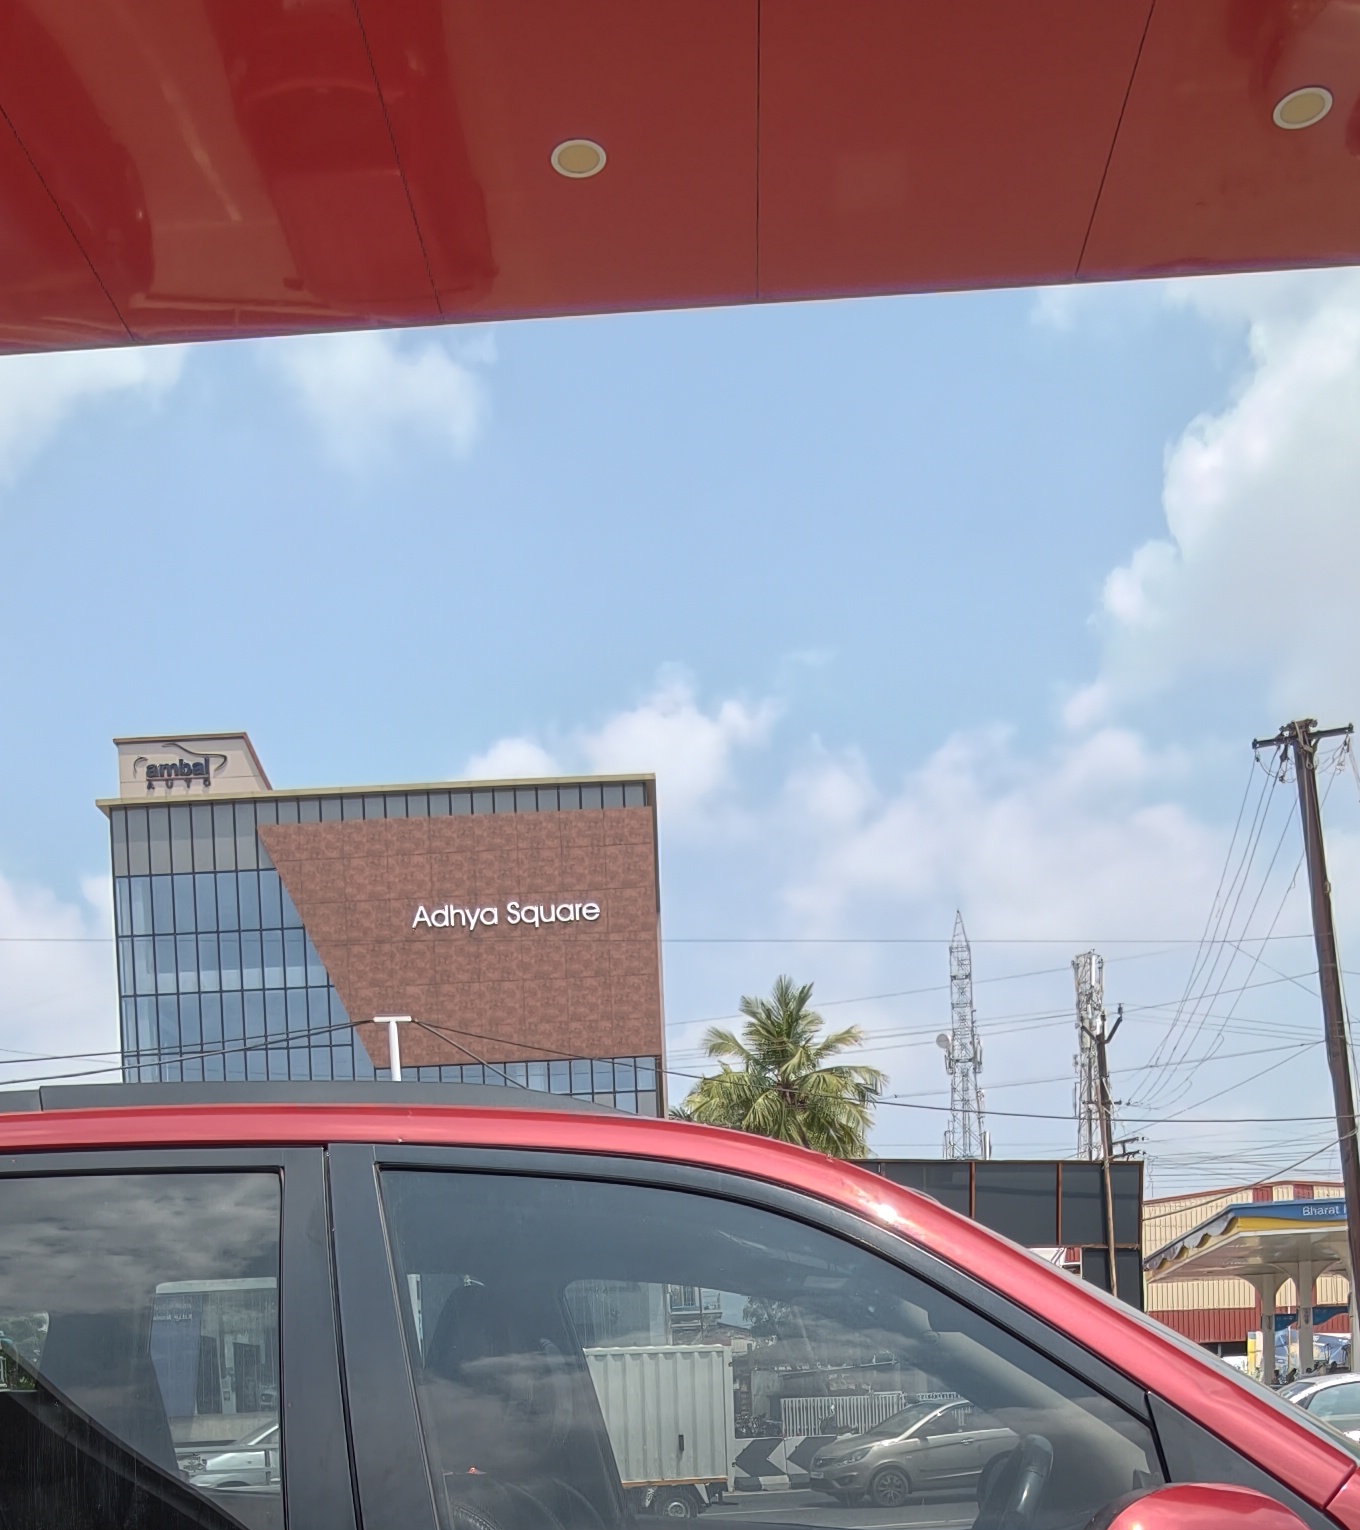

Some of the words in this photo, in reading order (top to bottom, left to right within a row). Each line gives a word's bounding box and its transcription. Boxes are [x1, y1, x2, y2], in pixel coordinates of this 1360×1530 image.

[146, 756, 210, 778] ambal
[412, 905, 498, 931] Adhya
[506, 901, 600, 928] Square
[1302, 1205, 1340, 1216] Bharat
